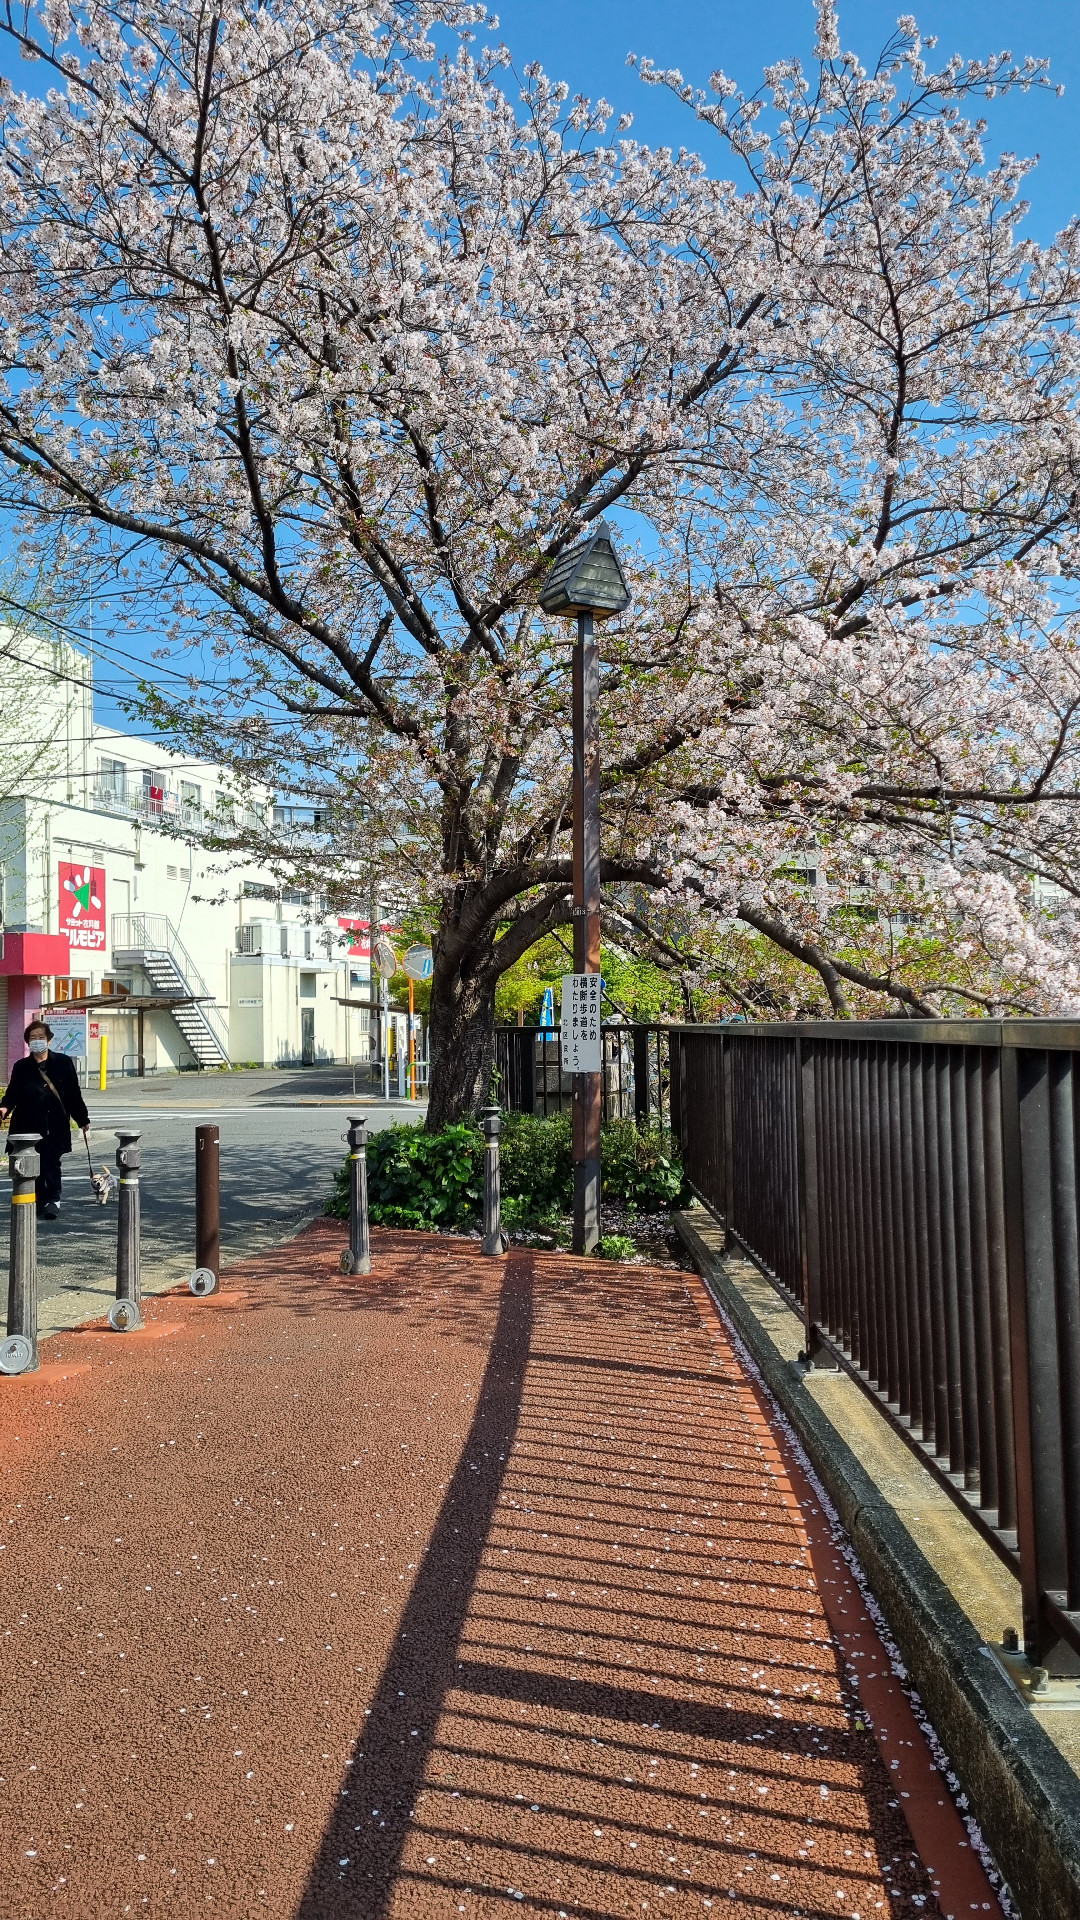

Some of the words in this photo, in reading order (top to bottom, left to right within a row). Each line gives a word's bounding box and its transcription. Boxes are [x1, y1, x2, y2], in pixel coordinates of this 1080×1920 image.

[572, 977, 580, 1071] わたりましょう。
[589, 977, 597, 1040] 安全のため
